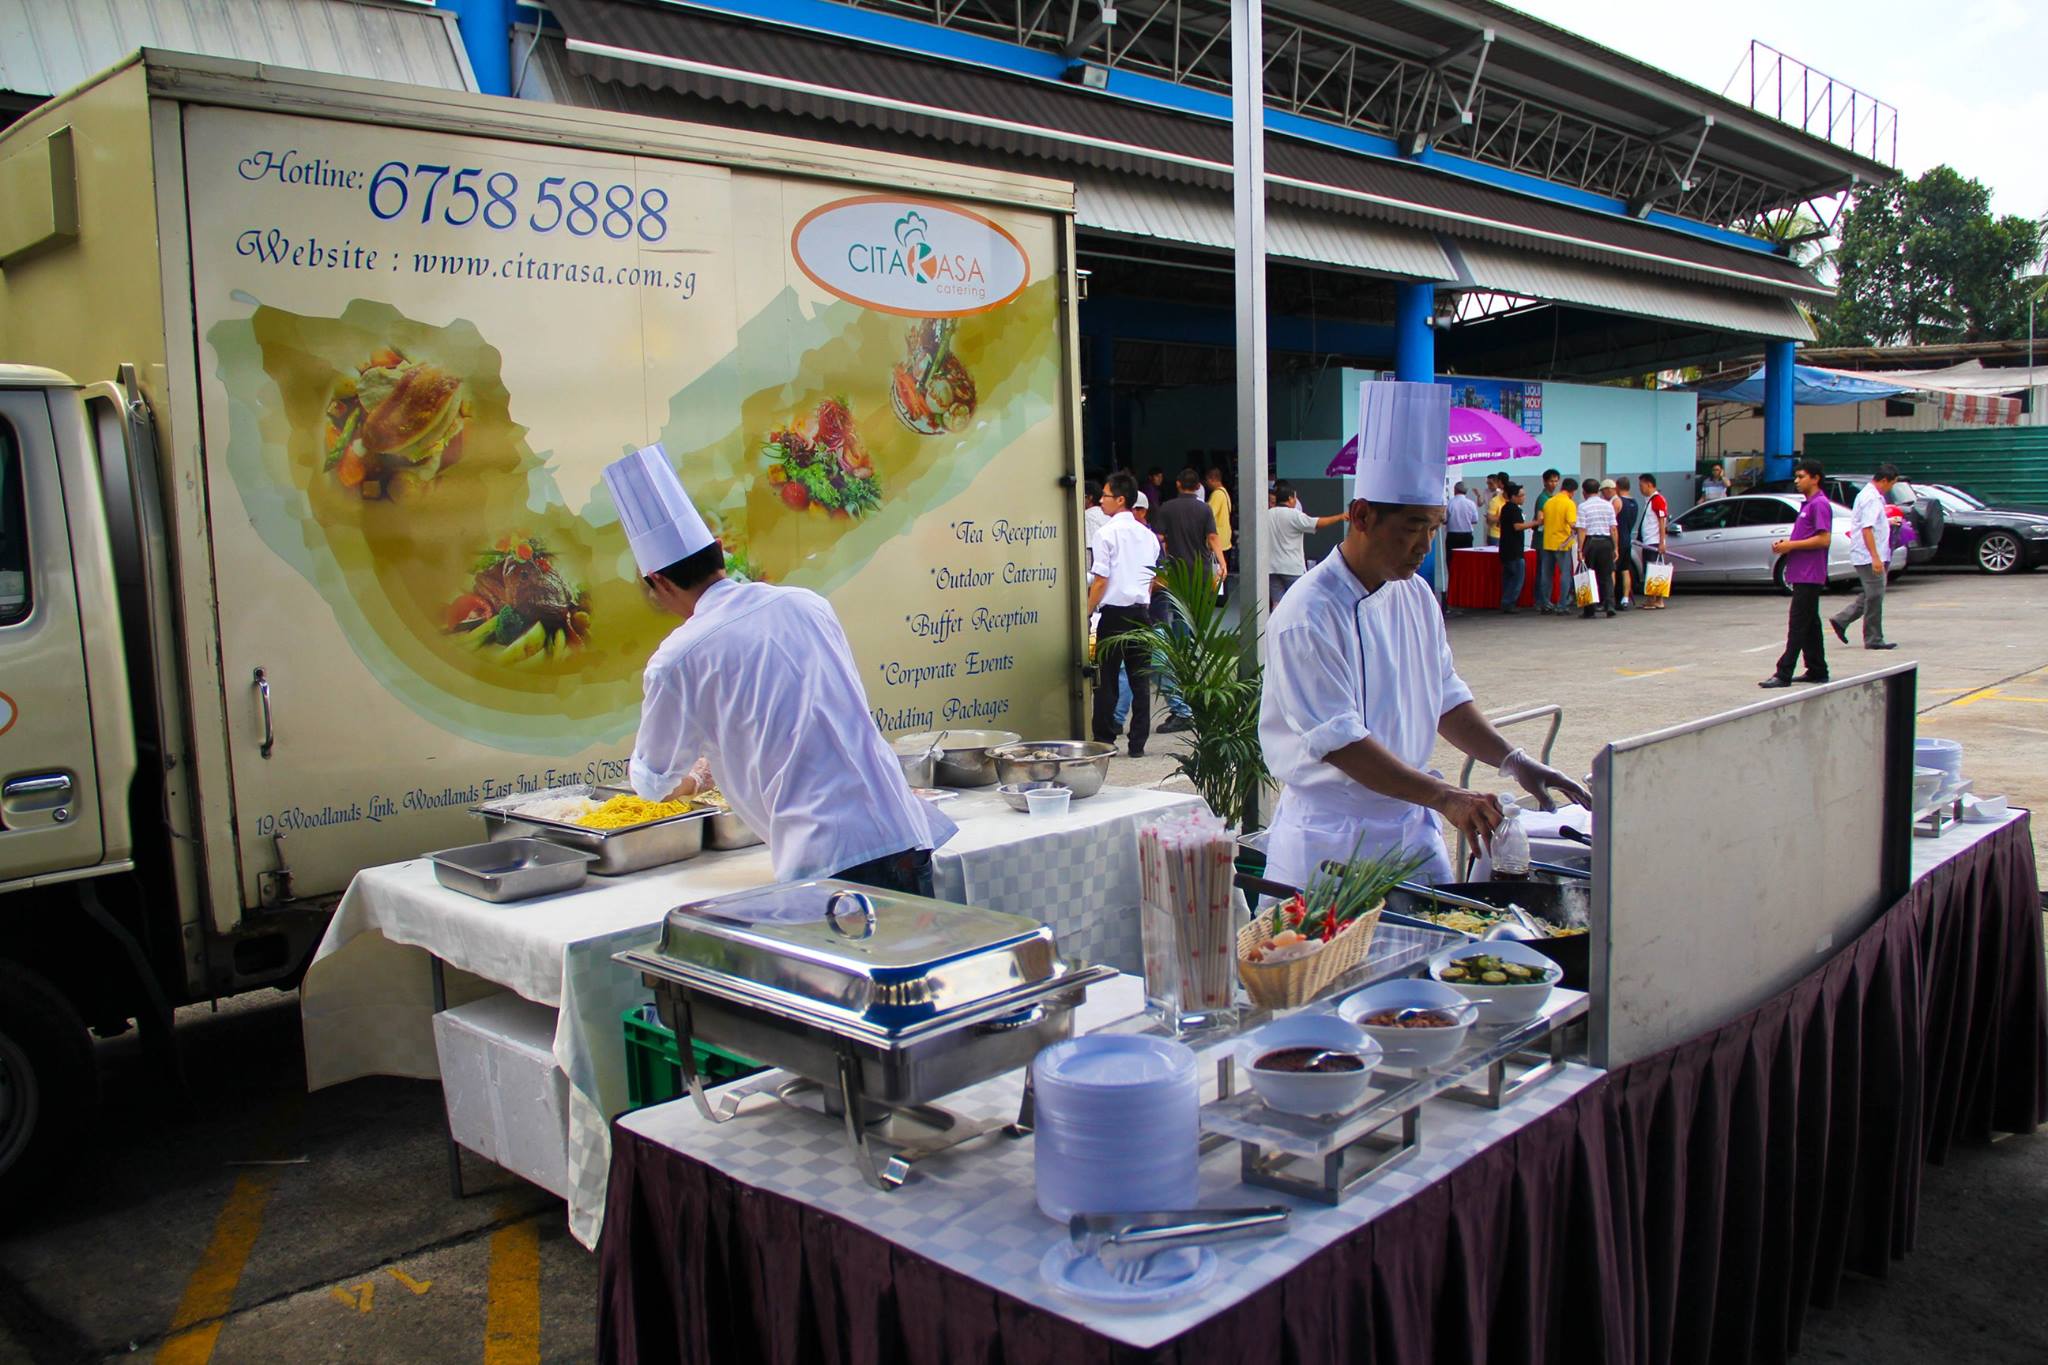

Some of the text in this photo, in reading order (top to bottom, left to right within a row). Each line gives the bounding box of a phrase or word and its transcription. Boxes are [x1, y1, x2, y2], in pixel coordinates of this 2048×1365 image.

[238, 150, 670, 243] Hotline: 6758 5888
[236, 228, 377, 270] Website
[413, 252, 697, 300] www.citarasa.com.sg
[936, 284, 986, 299] catering
[992, 519, 1057, 546] Reception
[1003, 562, 1057, 588] Catering
[972, 606, 1038, 633] Reception
[965, 651, 1014, 675] Events
[942, 698, 1009, 723] Packages
[278, 803, 361, 830] Woodlands
[402, 785, 479, 811] Woodlands
[483, 778, 513, 799] East
[516, 774, 541, 793] Ind.
[545, 769, 582, 789] Estate
